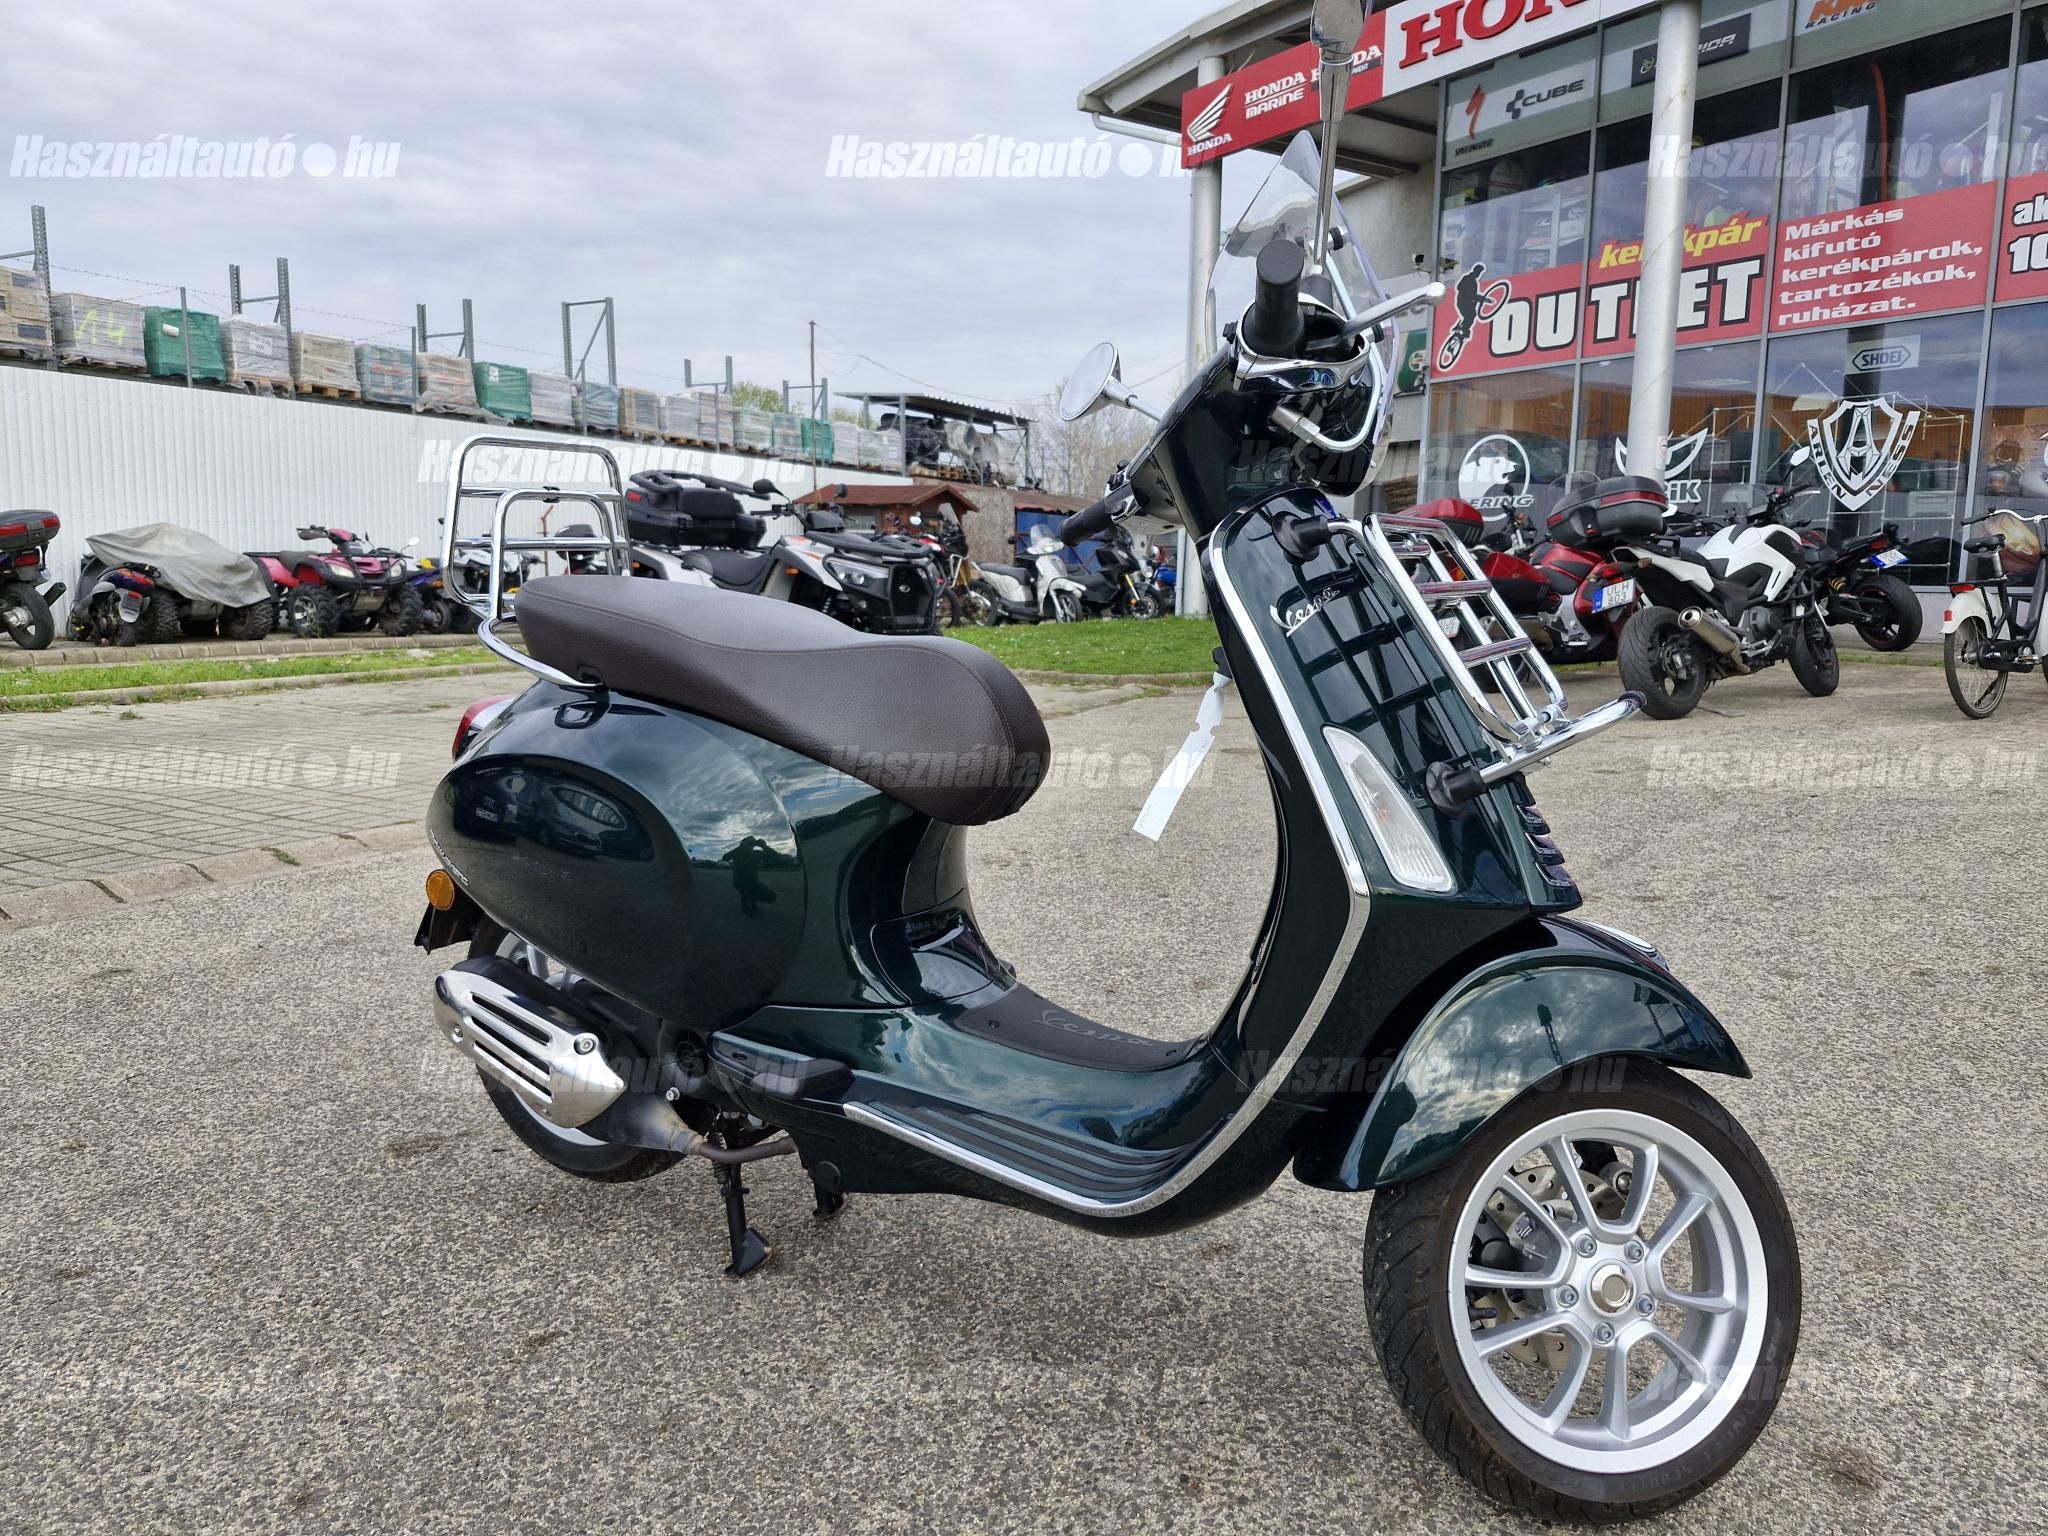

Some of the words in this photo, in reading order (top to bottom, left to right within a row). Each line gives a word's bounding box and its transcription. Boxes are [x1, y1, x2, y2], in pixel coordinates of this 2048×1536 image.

[1804, 2, 1877, 29] RACING
[1244, 71, 1306, 105] HONDA
[1245, 88, 1305, 119] MARINE
[1521, 79, 1585, 107] CUBE
[1187, 133, 1233, 156] HONDA
[1785, 208, 1904, 241] Márkás
[1599, 217, 1762, 269] kekpár
[1783, 232, 1881, 262] kifutó
[1782, 240, 1983, 284] kerékpárok,
[1779, 264, 1977, 305] tartozékok,
[1490, 254, 1764, 357] OUTET
[1778, 296, 1916, 326] ruházat.
[1808, 423, 1848, 500] ARLEN
[1866, 423, 1914, 497] NESS
[1470, 494, 1534, 510] ERING
[1269, 587, 1340, 637] Vespa
